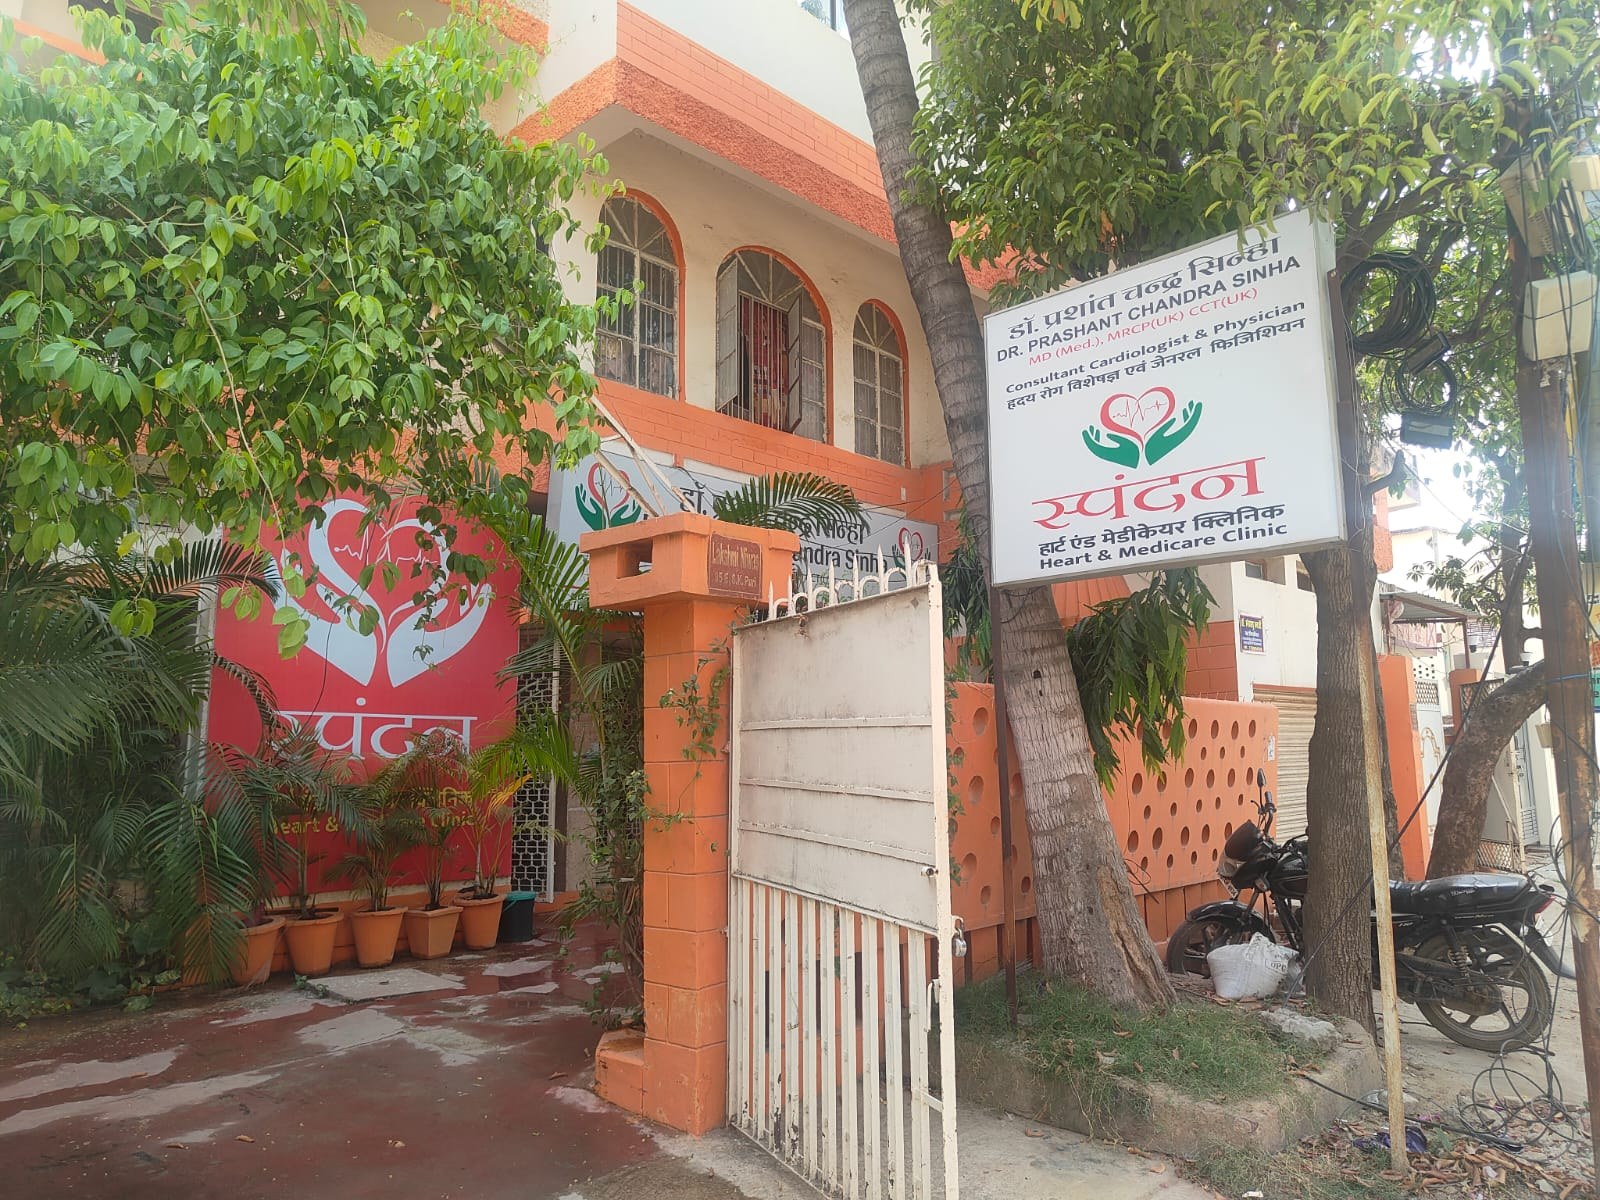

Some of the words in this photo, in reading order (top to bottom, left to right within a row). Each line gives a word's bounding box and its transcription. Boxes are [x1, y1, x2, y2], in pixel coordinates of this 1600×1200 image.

[997, 345, 1023, 362] DR.
[1029, 312, 1123, 352] PRASHANT
[1128, 280, 1227, 321] CHANDRA
[1232, 256, 1301, 288] SINHA
[1008, 314, 1039, 340] डॉ.
[1042, 293, 1117, 330] प्रशांत
[1121, 270, 1184, 301] चन्द्र
[1187, 236, 1282, 281] सिन्हा
[1029, 352, 1052, 366] MD
[1056, 336, 1104, 358] (Med.),
[1107, 312, 1184, 342] MRCP(UK)
[1189, 287, 1258, 317] CCT(UK)
[1006, 364, 1085, 393] Consultant
[1089, 333, 1189, 370] Cardiologist
[1194, 329, 1208, 340] &
[1213, 301, 1305, 334] Physician
[1007, 393, 1037, 410] हृदय
[1040, 384, 1065, 400] रोग
[1067, 368, 1121, 393] विशेषज्ञ
[1124, 360, 1147, 376] एवं
[1151, 346, 1202, 369] जेनरल
[1210, 317, 1306, 353] फिजिशियन
[1032, 456, 1266, 530] स्पंदन
[1038, 535, 1067, 556] हार्ट
[1069, 534, 1097, 550] एंड
[1101, 518, 1187, 545] मेडीकेयर
[1192, 503, 1286, 532] क्लिनिक
[1040, 552, 1093, 570] Heart
[1098, 549, 1112, 561] &
[1119, 534, 1216, 559] Medicare
[1222, 522, 1288, 542] Clinic
[325, 816, 338, 833] &
